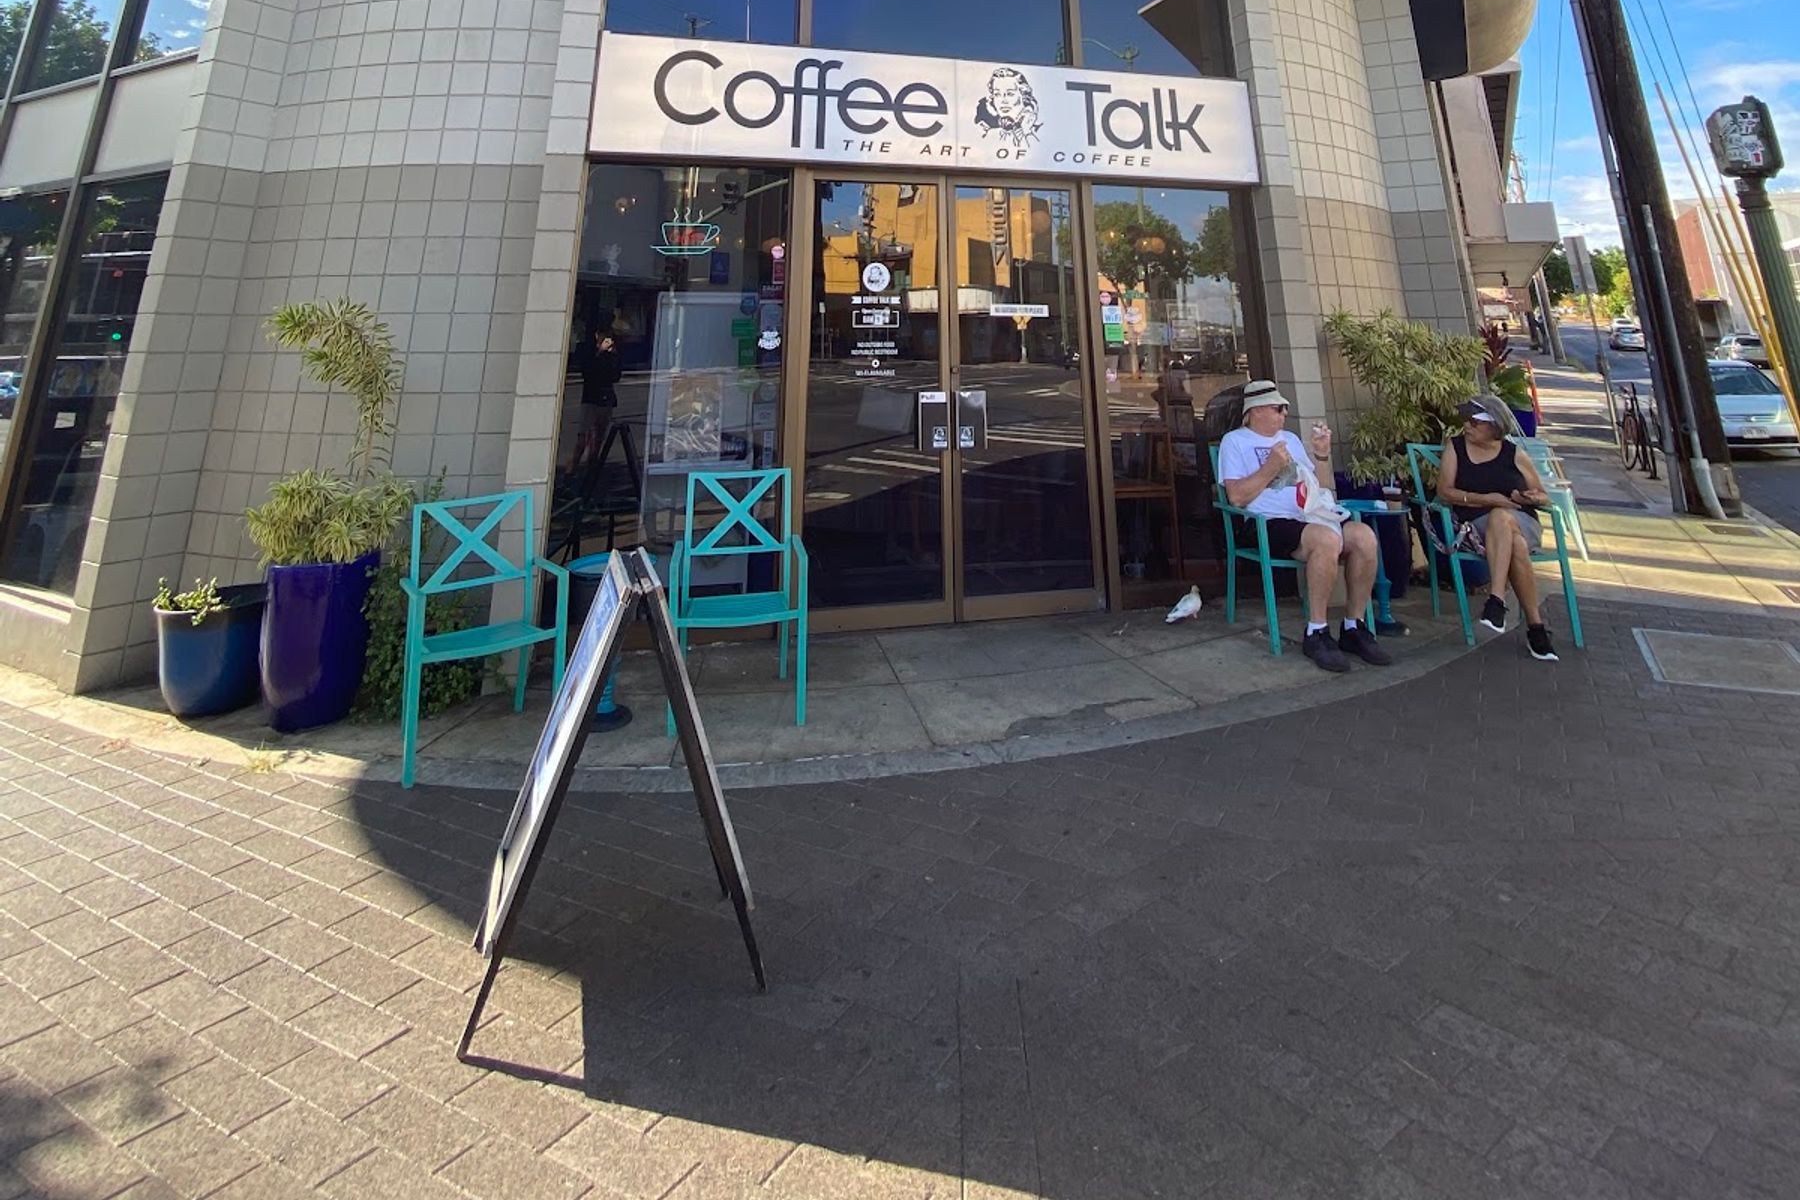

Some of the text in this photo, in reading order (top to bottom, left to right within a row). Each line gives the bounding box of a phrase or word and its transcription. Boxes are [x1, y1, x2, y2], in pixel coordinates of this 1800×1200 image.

[654, 50, 1211, 153] Coffee Talk
[843, 139, 1151, 168] THE ART OF COFFEE
